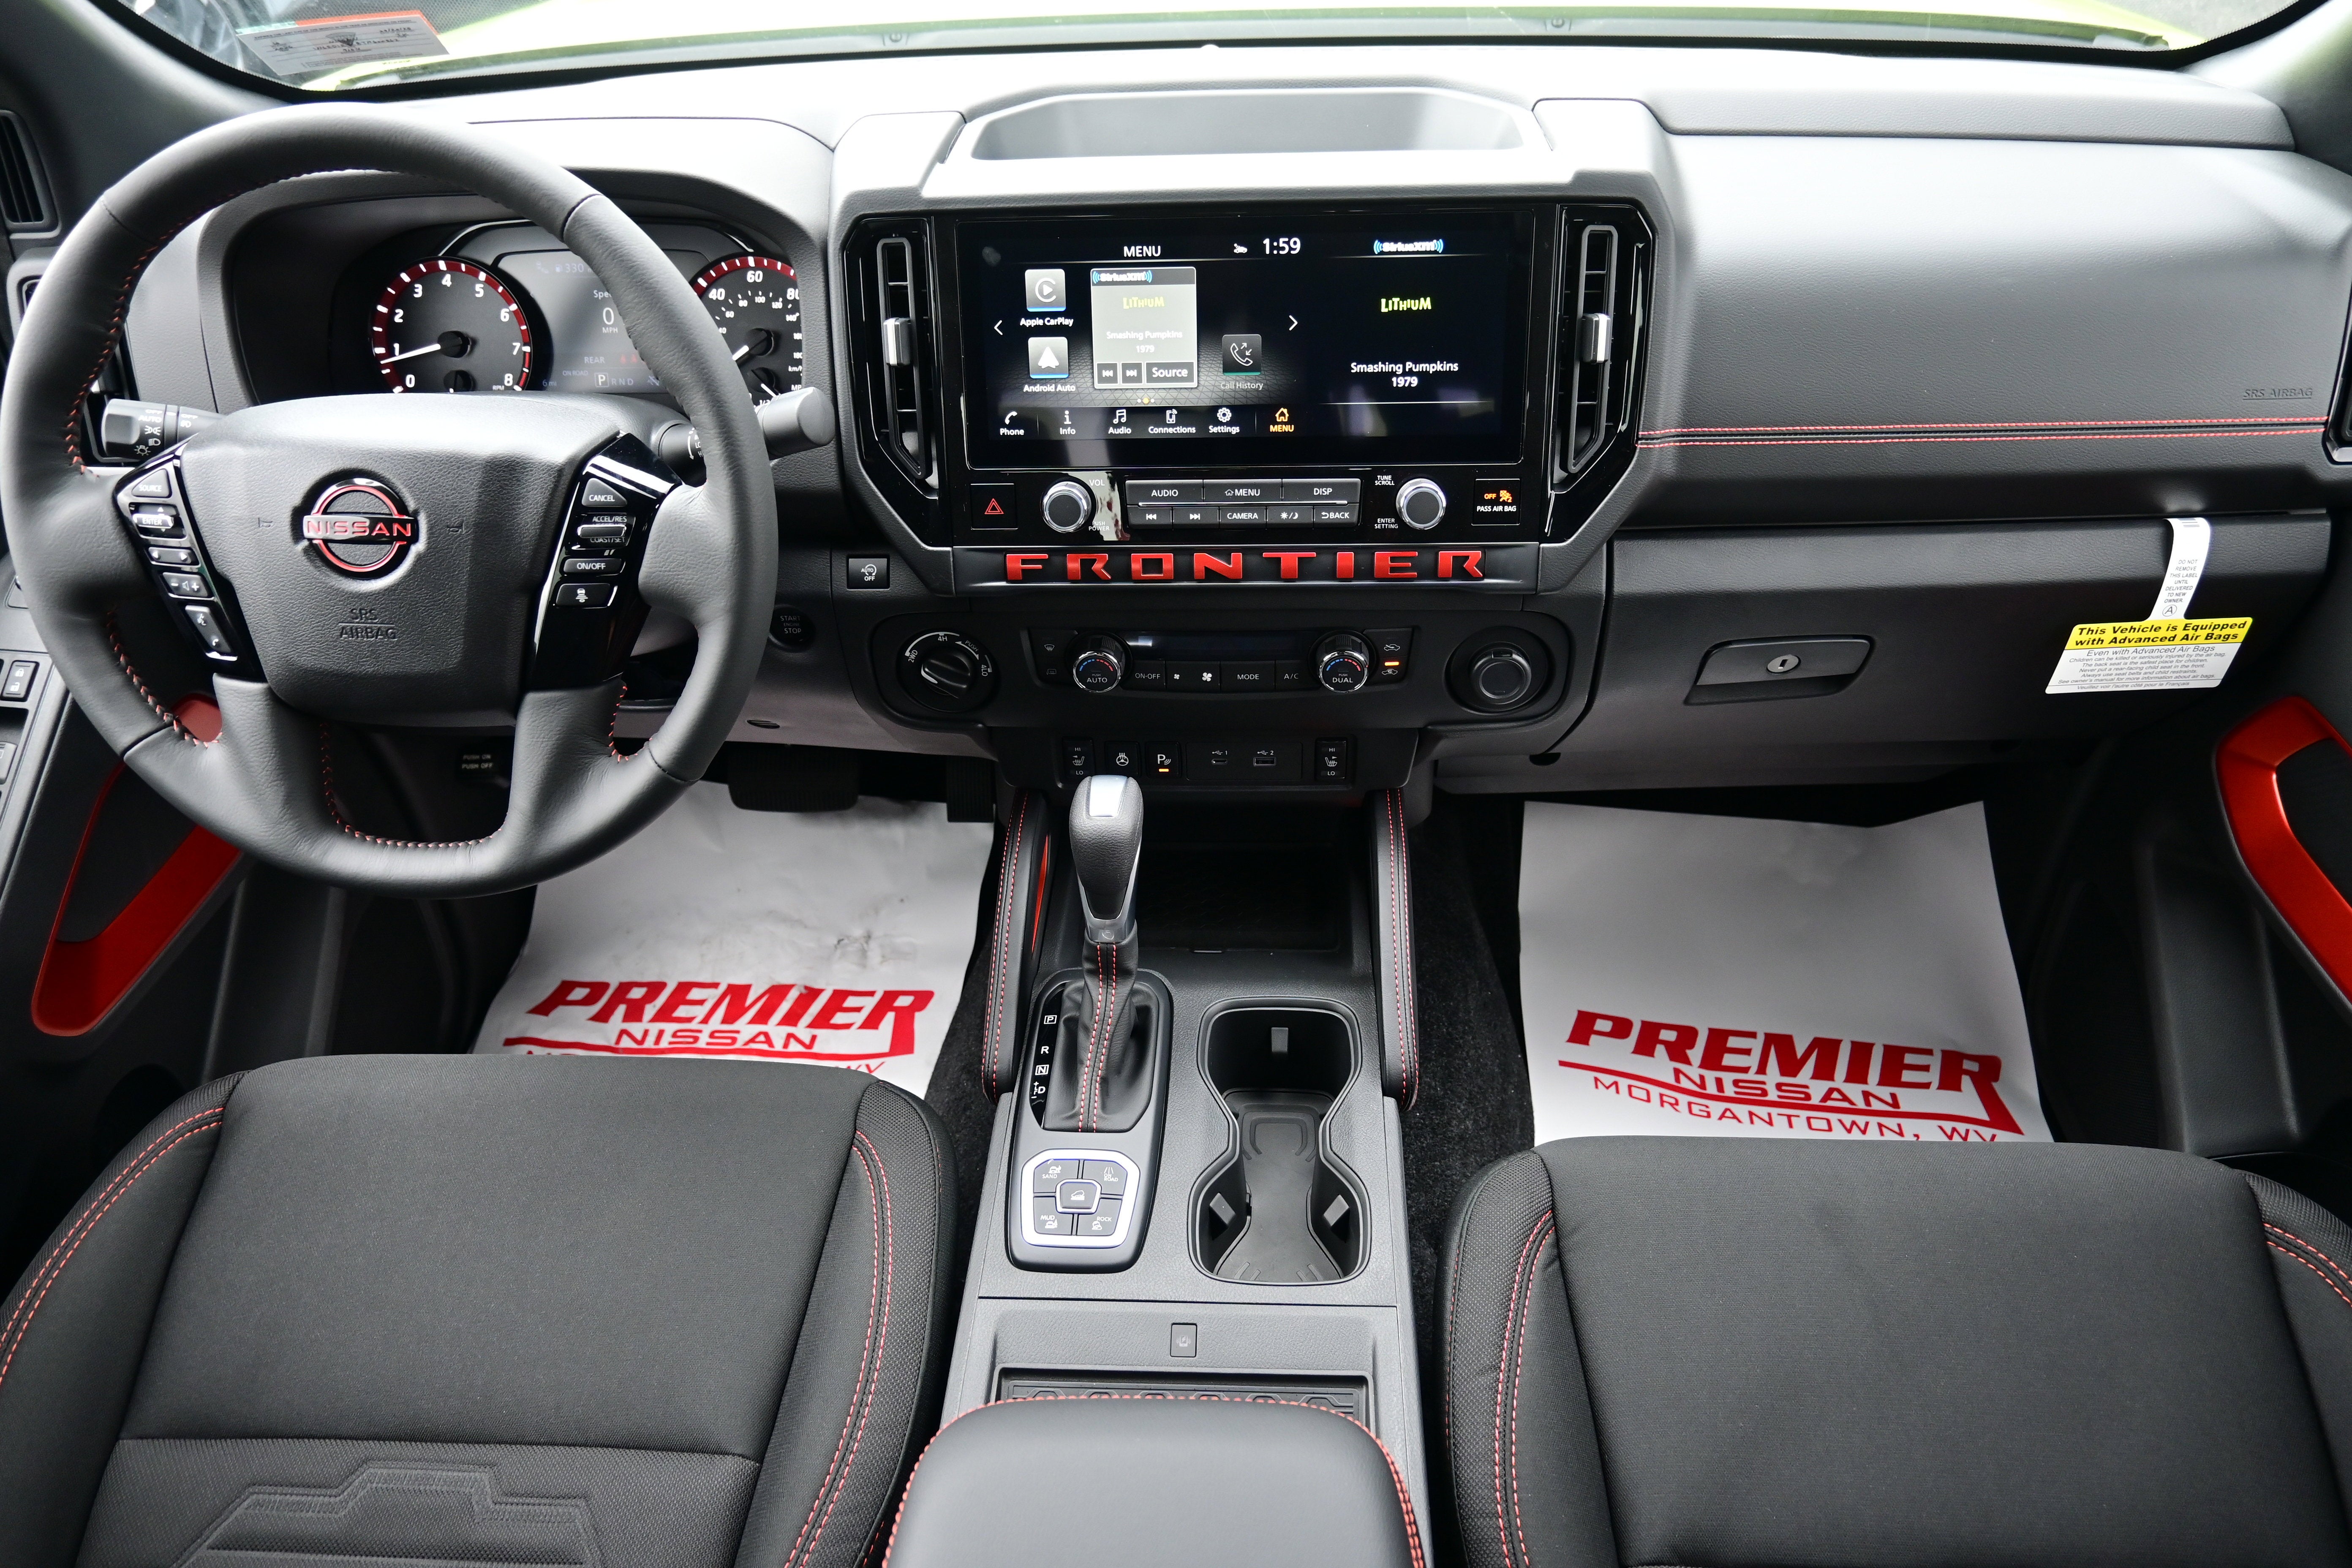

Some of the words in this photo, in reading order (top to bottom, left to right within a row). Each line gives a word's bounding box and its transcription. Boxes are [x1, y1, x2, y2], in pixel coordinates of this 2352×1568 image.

[1123, 246, 1161, 257] MENU
[1263, 237, 1301, 255] 1:59
[565, 263, 584, 272] 330
[442, 274, 452, 287] 4
[746, 270, 763, 283] 60
[414, 284, 423, 297] 3
[475, 284, 484, 297] 5
[708, 288, 725, 300] 40
[394, 309, 404, 323] 2
[500, 308, 509, 322] 6
[603, 307, 614, 325] 0
[1020, 318, 1043, 327] Apple
[1045, 317, 1074, 327] CarPlay
[1106, 330, 1144, 341] Smashing
[1145, 330, 1183, 340] Pumpkins
[393, 343, 400, 356] 1
[512, 342, 521, 355] 7
[1136, 345, 1155, 353] 1979
[1152, 367, 1188, 377] Source
[1351, 362, 1403, 374] Smashing
[1405, 361, 1459, 374] Pumpkins
[406, 374, 415, 387] 0
[504, 373, 513, 386] 8
[598, 375, 606, 386] P
[1392, 376, 1418, 387] 1979
[1024, 384, 1055, 392] Android
[1056, 384, 1076, 392] Auto
[1236, 381, 1263, 391] History
[2243, 389, 2265, 397] SRS
[2270, 388, 2313, 397] AIRBAG
[138, 415, 162, 423] AUTO
[1000, 427, 1024, 436] Phone
[1059, 427, 1076, 435] Info
[1108, 426, 1132, 434] Audio
[1149, 426, 1196, 434] Connections
[1209, 425, 1240, 434] Settings
[1151, 489, 1178, 497] AUDIO
[1235, 488, 1260, 497] MENU
[307, 520, 411, 536] NISSAN
[1006, 550, 1483, 581] FRONTIER
[350, 608, 379, 622] SRS
[339, 626, 399, 641] AIRBAG
[2078, 627, 2107, 635] This
[2112, 624, 2162, 634] Vehicle
[2166, 623, 2178, 632] is
[2182, 621, 2247, 632] Equipped
[2075, 637, 2104, 646] with
[2108, 634, 2178, 645] Advanced
[2179, 633, 2201, 641] Air
[2204, 632, 2239, 642] Bags
[965, 640, 979, 652] PUSH
[2130, 646, 2177, 655] Advanced
[908, 649, 918, 663] 2WD
[1157, 754, 1166, 764] P
[526, 980, 934, 1032] PREMIER
[614, 1028, 818, 1050] NISSAN
[1040, 1046, 1049, 1054] R
[1566, 1010, 2003, 1095] PREMIER
[1037, 1066, 1046, 1074] N
[1037, 1086, 1046, 1094] D
[1673, 1066, 1902, 1110] NISSAN
